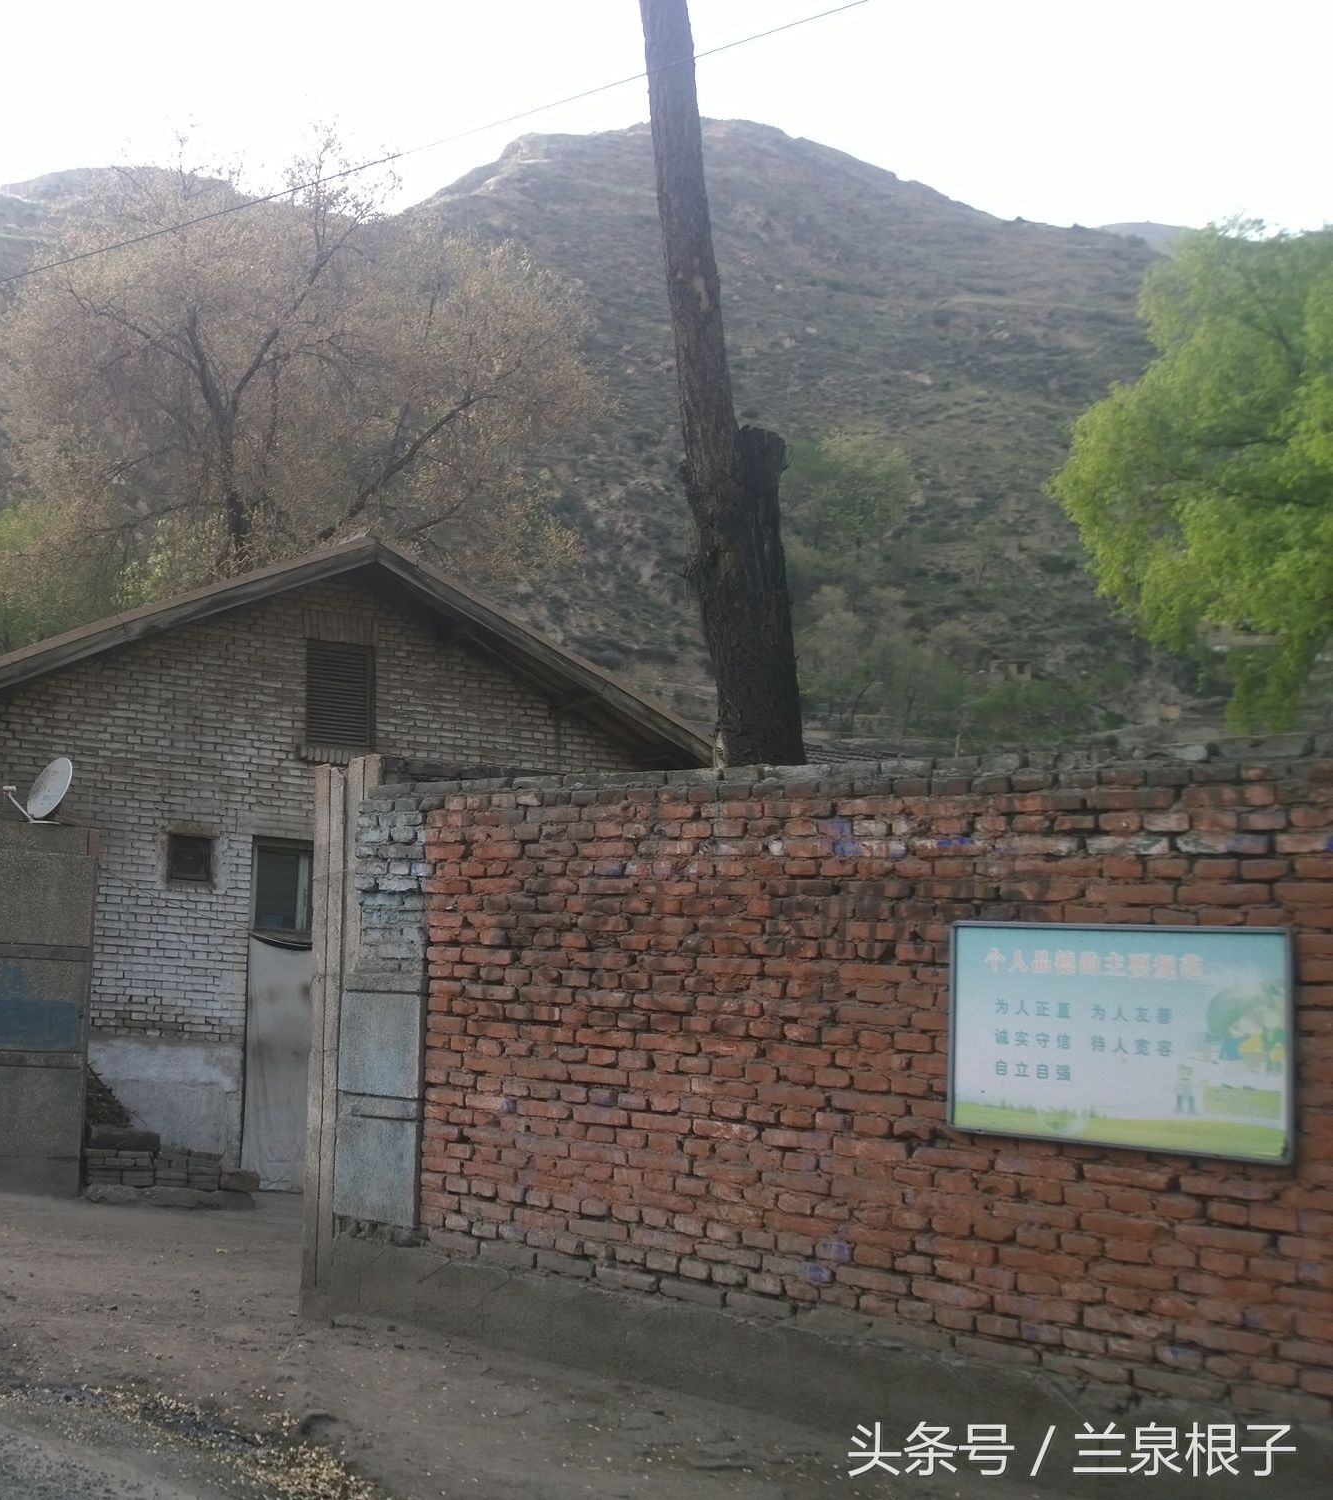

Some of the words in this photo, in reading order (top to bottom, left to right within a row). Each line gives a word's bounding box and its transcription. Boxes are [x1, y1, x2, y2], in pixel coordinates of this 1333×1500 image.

[994, 998, 1072, 1020] 为人正直
[1090, 1003, 1173, 1025] 为人友善
[994, 1028, 1072, 1050] 诚实守信
[994, 1059, 1072, 1082] 自立自强
